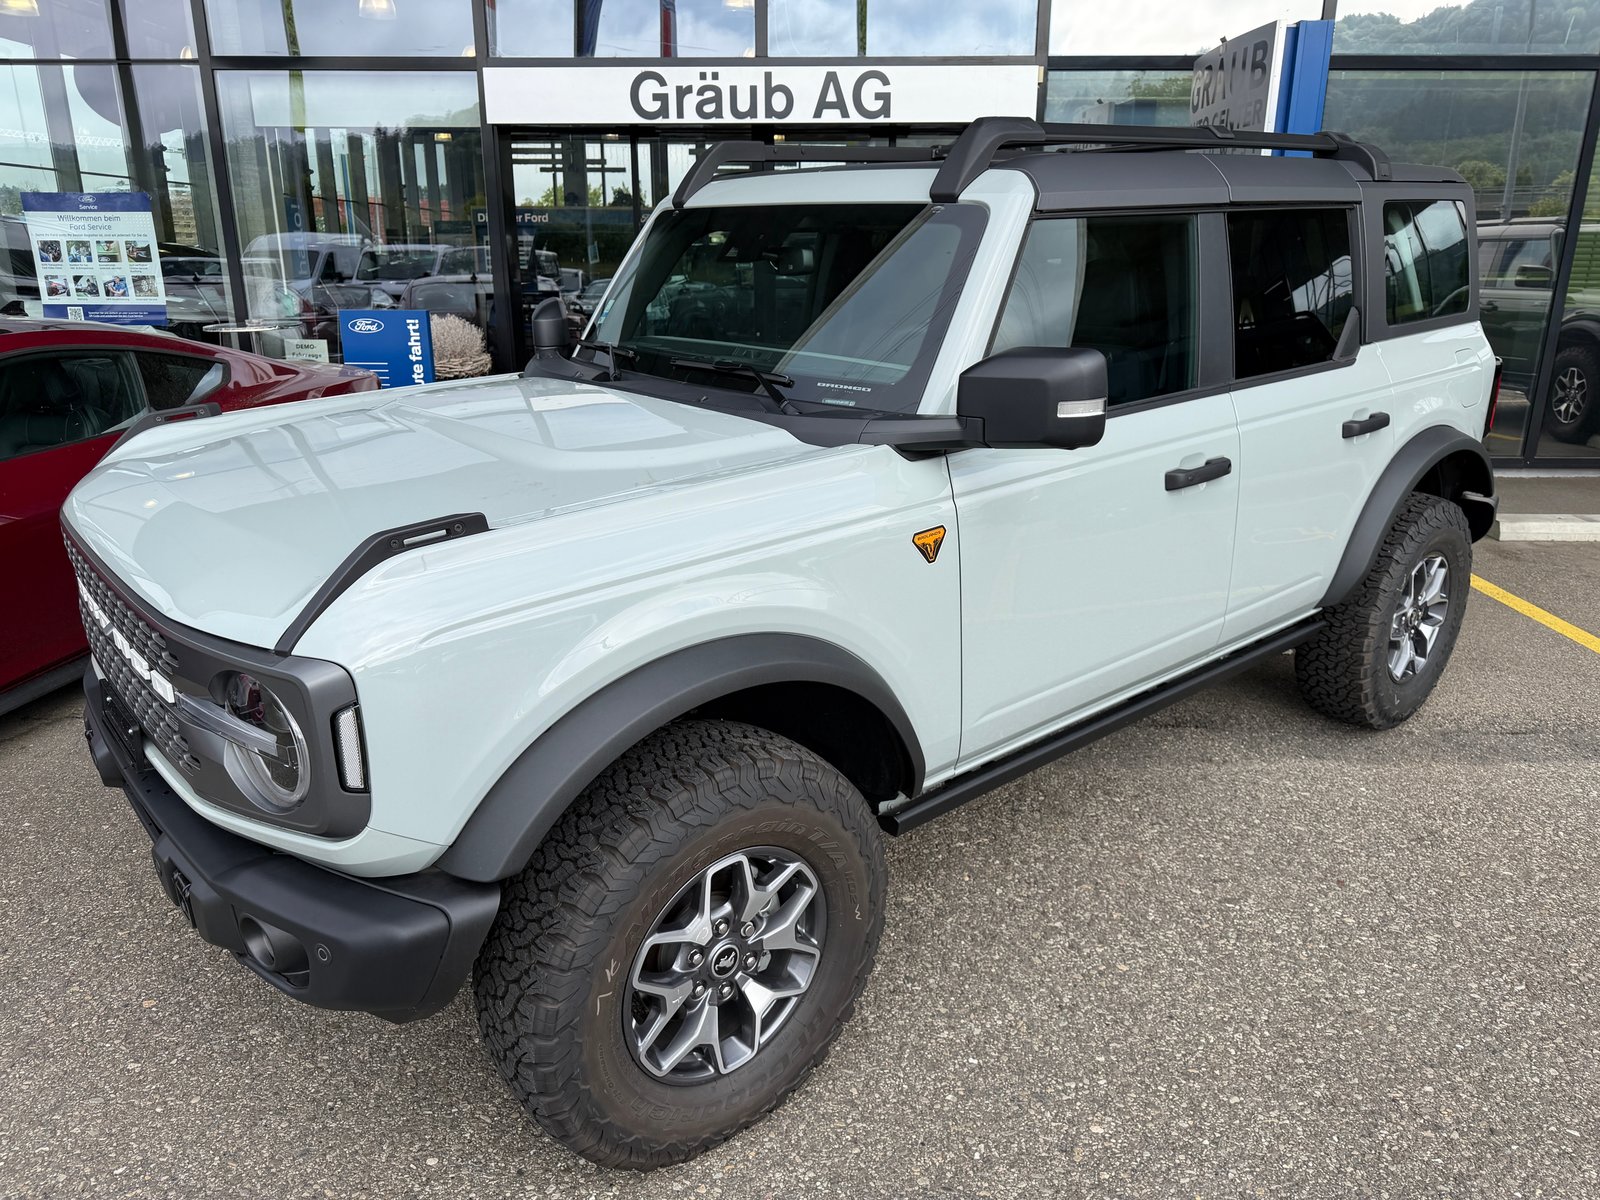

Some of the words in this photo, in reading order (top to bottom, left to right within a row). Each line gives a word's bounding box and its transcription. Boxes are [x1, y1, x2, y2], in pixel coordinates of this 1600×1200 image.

[629, 69, 795, 120] Gräub
[812, 69, 892, 120] AG
[57, 214, 103, 222] Willkommen
[103, 214, 121, 222] beim
[524, 212, 549, 223] Ford
[69, 223, 86, 231] Ford
[87, 223, 112, 231] Service
[405, 319, 422, 362] fahrt!
[817, 382, 872, 392] BRONCO
